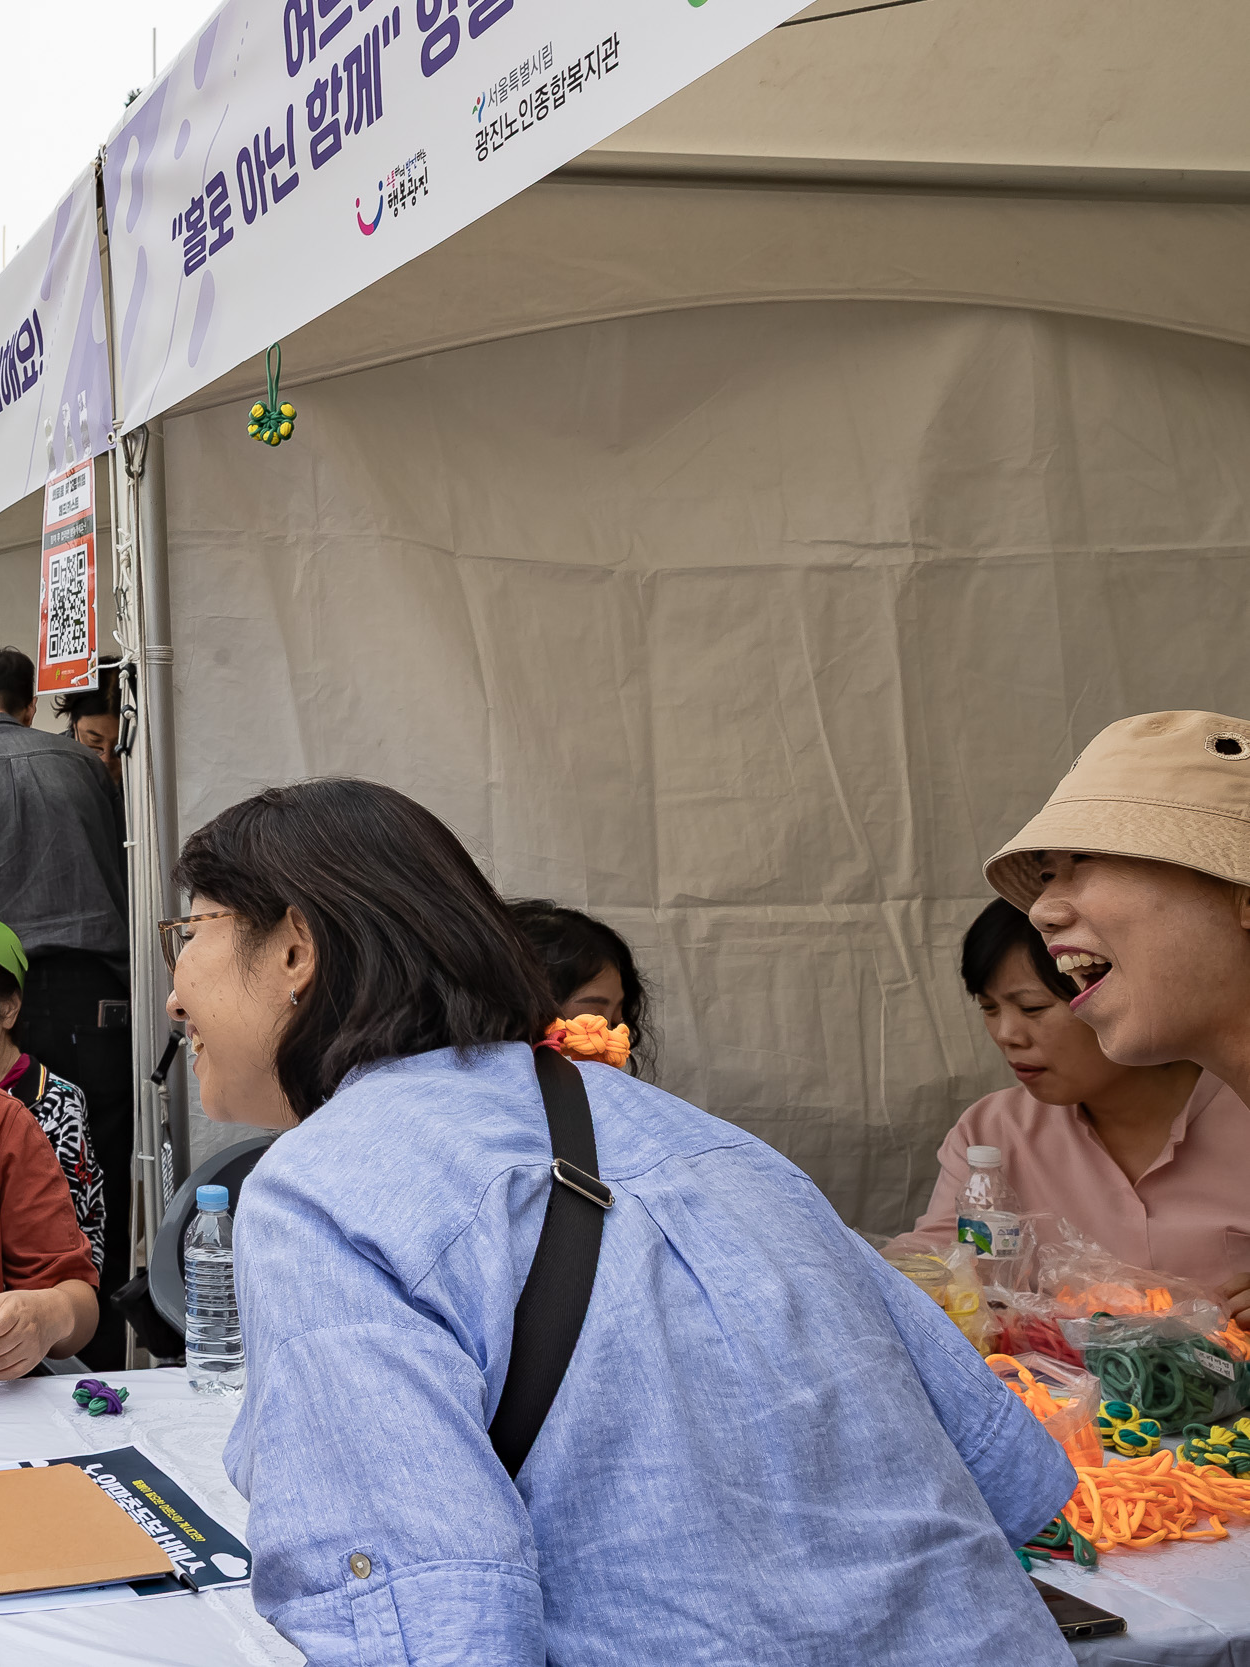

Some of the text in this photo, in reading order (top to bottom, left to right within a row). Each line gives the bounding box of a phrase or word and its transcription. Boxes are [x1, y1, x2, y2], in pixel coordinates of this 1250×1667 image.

[237, 104, 299, 225] 아닌
[306, 6, 401, 170] 함께"
[475, 32, 620, 162] 광진노인종합복지관
[487, 41, 553, 107] 서울특별시립
[387, 166, 429, 217] 행복광진
